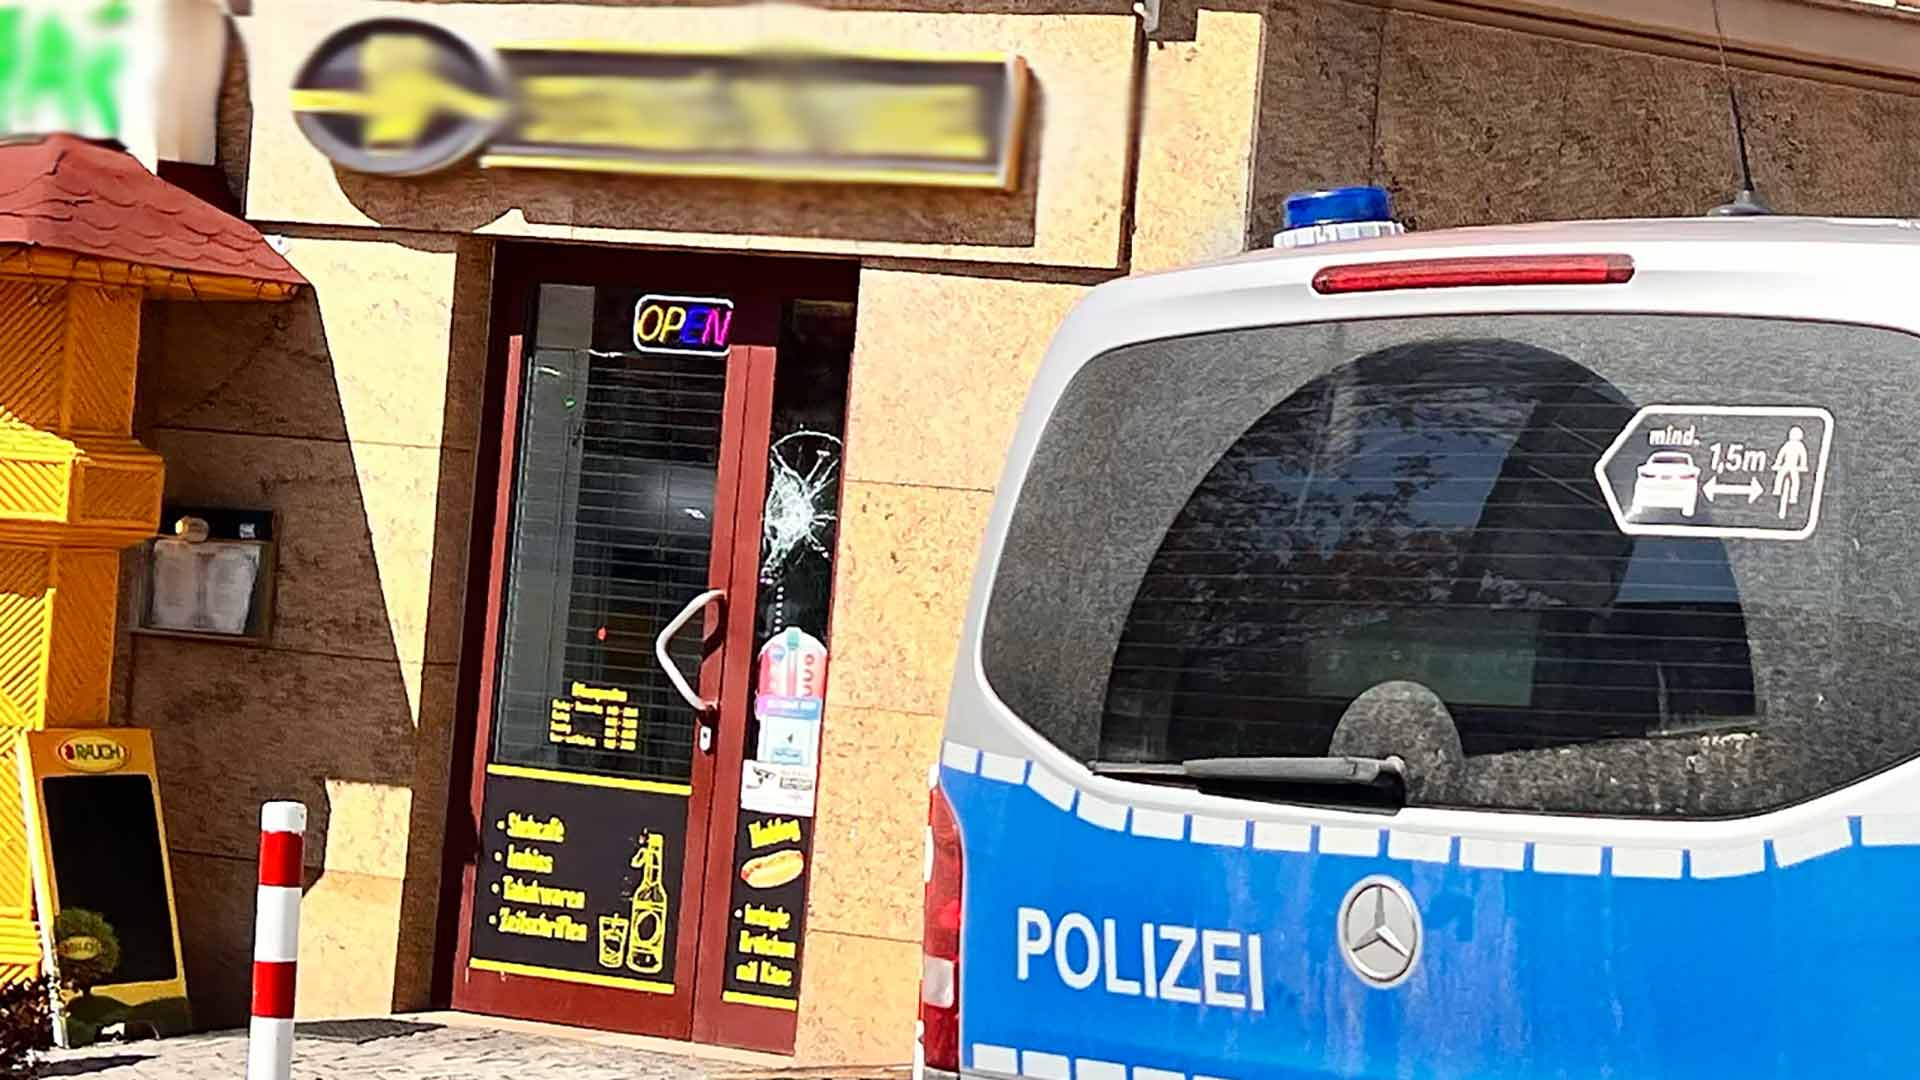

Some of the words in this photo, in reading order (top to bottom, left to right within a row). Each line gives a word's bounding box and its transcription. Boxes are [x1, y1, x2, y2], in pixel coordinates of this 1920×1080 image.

[637, 305, 733, 347] OPEN
[1649, 424, 1700, 446] mind.
[1710, 442, 1766, 474] 1,5m
[75, 744, 121, 760] RAUCH
[1016, 906, 1265, 1011] POLIZEI
